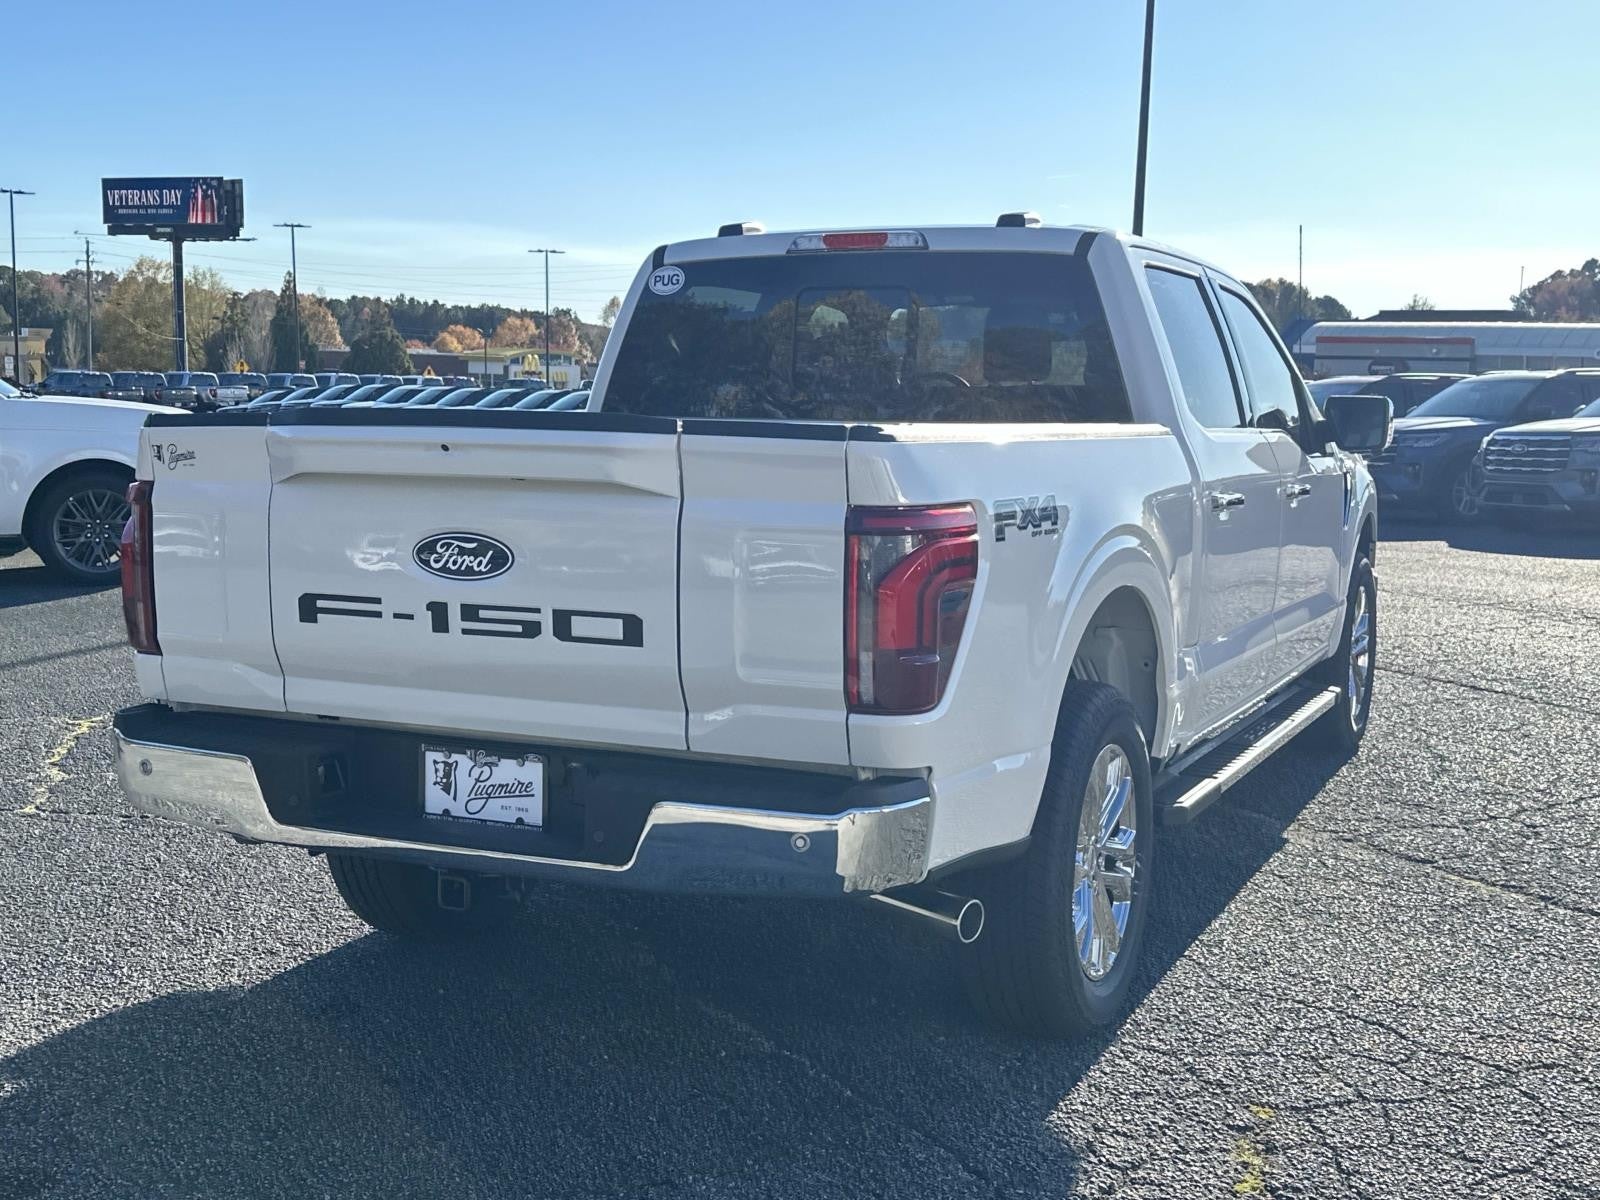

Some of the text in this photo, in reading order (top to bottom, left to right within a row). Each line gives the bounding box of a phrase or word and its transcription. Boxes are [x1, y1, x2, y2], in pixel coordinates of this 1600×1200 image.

[107, 189, 183, 206] VETERANS DAY
[653, 273, 681, 287] PUG
[993, 494, 1059, 543] FX4
[429, 539, 493, 574] Ford
[298, 592, 644, 649] F-150
[464, 763, 535, 815] Pugmire
